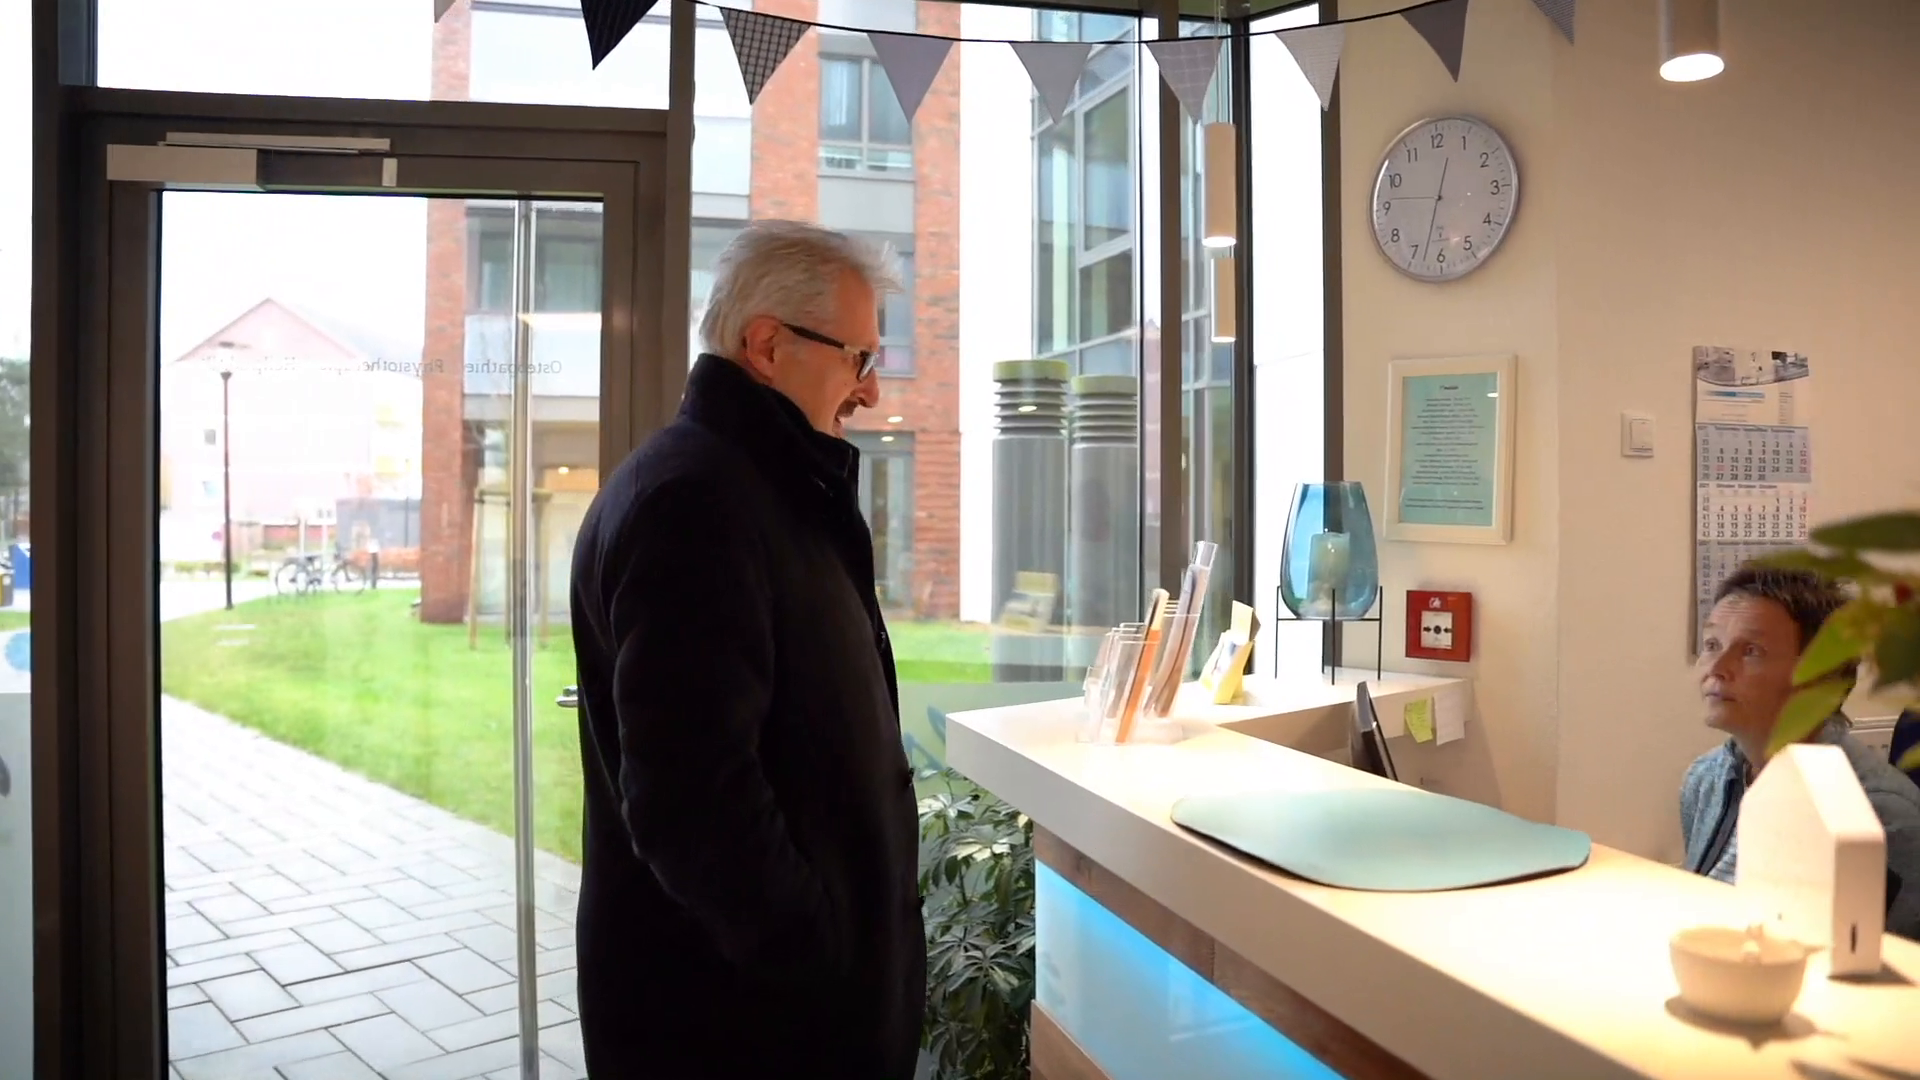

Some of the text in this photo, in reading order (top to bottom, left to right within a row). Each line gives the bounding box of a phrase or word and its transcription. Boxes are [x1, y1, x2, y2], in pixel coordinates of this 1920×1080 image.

[1430, 133, 1444, 149] 12
[1462, 135, 1466, 150] 1
[1405, 147, 1418, 163] 11
[1480, 152, 1489, 168] 2
[1388, 173, 1402, 189] 10
[1490, 179, 1500, 195] 3
[1382, 201, 1391, 216] 9
[1482, 212, 1492, 226] 4
[1391, 228, 1400, 243] 8
[1463, 235, 1473, 251] 5
[1410, 244, 1419, 259] 7
[1436, 248, 1446, 263] 6
